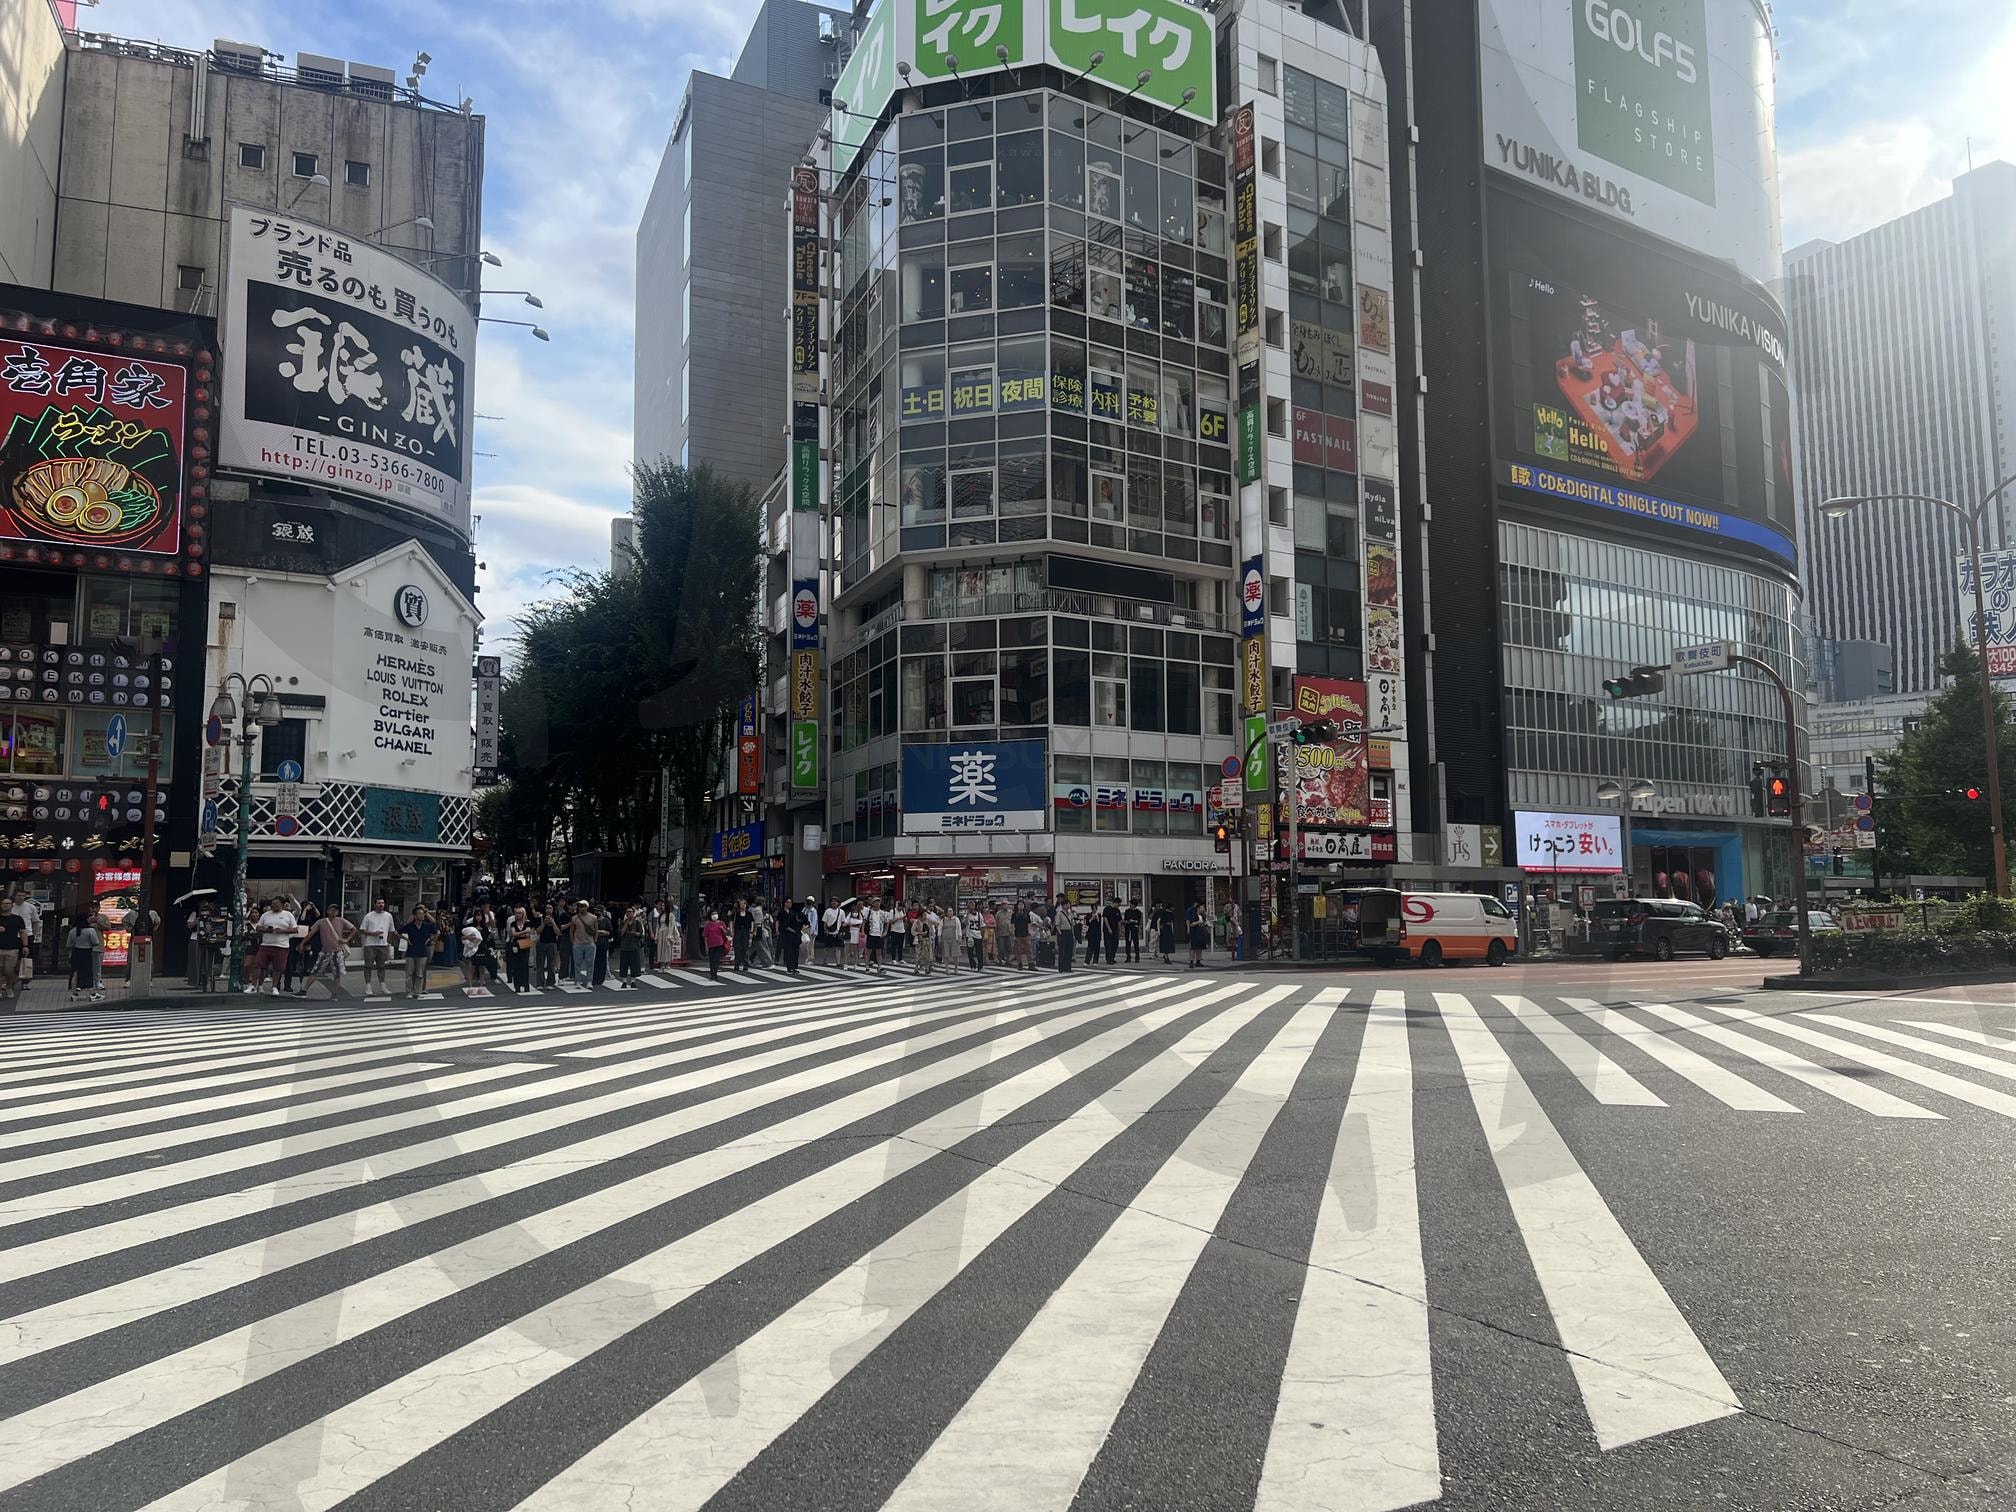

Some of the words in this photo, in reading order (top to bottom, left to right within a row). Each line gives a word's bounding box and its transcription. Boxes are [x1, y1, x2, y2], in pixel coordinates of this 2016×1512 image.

[1586, 0, 1696, 84] GOLF5
[1588, 79, 1701, 145] FLAGSHIP
[1634, 128, 1703, 171] STORE
[1497, 133, 1580, 194] YUNIKA
[1584, 172, 1635, 216] BLDG.
[1246, 182, 1254, 232] Cheese
[250, 219, 352, 263] ブランド品
[1245, 239, 1255, 251] 7F
[796, 245, 805, 279] Table
[807, 243, 815, 285] Cheese
[795, 292, 807, 300] 7F
[1535, 280, 1554, 295] Hello
[1686, 292, 1750, 340] YUNIKA
[1753, 320, 1784, 367] VISION
[1, 345, 172, 410] 壱角家
[271, 307, 456, 448] 銀蔵
[953, 386, 993, 409] 祝日
[1001, 377, 1045, 402] 夜間
[1053, 375, 1083, 393] 保険
[1091, 385, 1121, 410] 内科
[1127, 393, 1158, 409] 予約
[1127, 408, 1158, 426] 不要
[1201, 413, 1224, 437] 6F
[1296, 411, 1306, 421] 6F
[1537, 407, 1563, 430] Hello
[52, 412, 152, 450] ラーメン
[1297, 430, 1352, 452] FASTNAIL
[1569, 428, 1608, 453] Hello
[261, 448, 393, 492] http://ginzo.jp
[1365, 491, 1386, 503] Rydia
[1539, 473, 1615, 505] CD&DIGITAL
[1617, 491, 1658, 516] SINGLE
[1661, 503, 1683, 520] OUT
[1686, 508, 1719, 530] NOW!!
[1245, 581, 1261, 602] 薬
[1992, 590, 2009, 611] の
[405, 591, 423, 622] 質
[796, 600, 814, 618] 薬
[363, 626, 404, 645] 高価買取
[376, 653, 435, 677] HERMÈS
[1248, 639, 1262, 711] 肉汁水餃子
[367, 669, 396, 686] LOUIS
[402, 675, 443, 695] VUITTON
[799, 653, 812, 715] 肉汁水餃子
[383, 688, 428, 707] ROLEX
[380, 705, 429, 724] Cartier
[481, 681, 494, 763] 質・買取・販売
[373, 721, 434, 740] BVLGARI
[375, 736, 432, 755] CHANEL
[797, 731, 812, 775] レイク
[949, 751, 998, 806] 薬
[1631, 796, 1686, 818] Alpen
[1686, 793, 1737, 816] TOKYO
[1325, 837, 1363, 856] 日高屋
[1163, 860, 1217, 870] PANDORA
[1507, 887, 1513, 899] P
